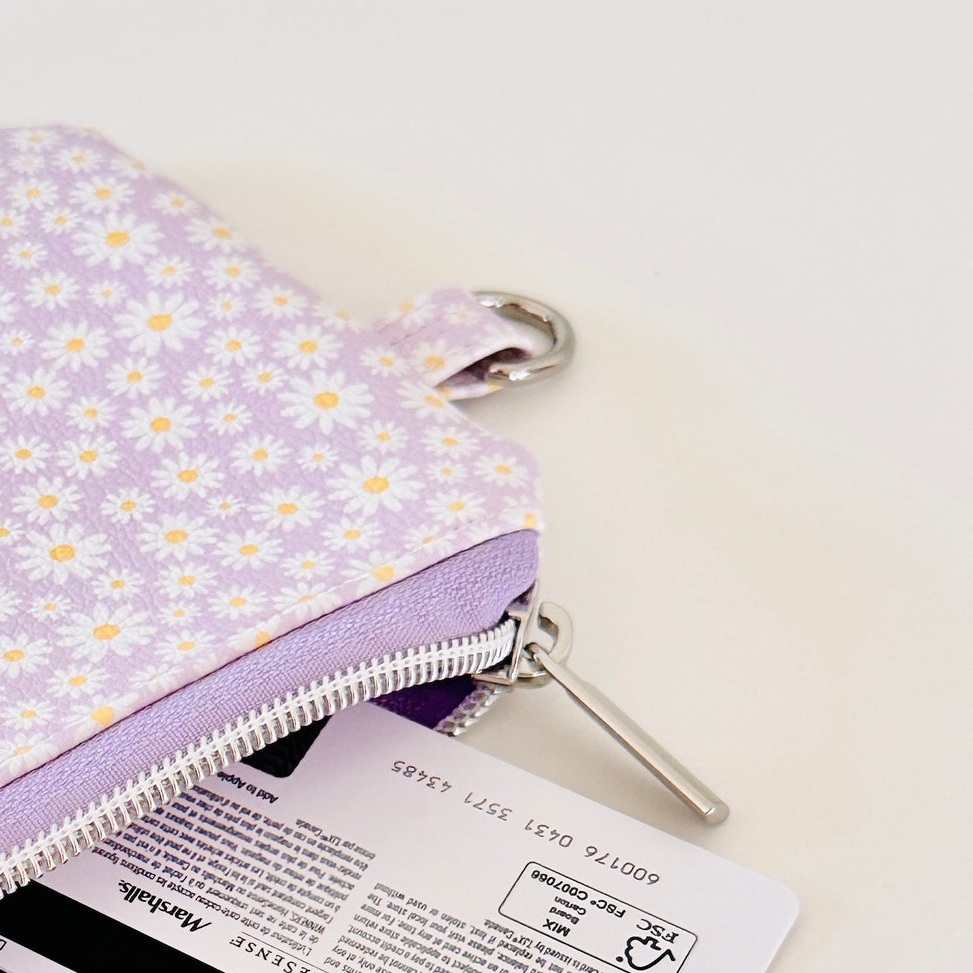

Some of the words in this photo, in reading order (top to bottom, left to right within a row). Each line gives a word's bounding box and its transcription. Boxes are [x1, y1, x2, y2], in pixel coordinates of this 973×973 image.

[216, 771, 247, 789] Apple
[391, 760, 451, 792] 43485
[245, 783, 257, 795] to
[255, 788, 277, 804] Add
[464, 792, 512, 821] 3571
[524, 819, 573, 848] 0431
[584, 845, 660, 885] 600176
[373, 882, 405, 900] without
[367, 893, 383, 906] The
[405, 897, 427, 911] used
[554, 896, 586, 915] Carton
[360, 903, 382, 917] more
[428, 908, 439, 916] or
[548, 906, 580, 925] Board
[353, 913, 379, 929] return
[380, 913, 396, 926] For
[406, 912, 429, 927] local
[440, 913, 467, 929] stolen
[378, 925, 400, 939] store
[428, 921, 448, 934] your
[542, 918, 571, 937] MIX
[636, 918, 679, 944] FSC
[417, 929, 433, 941] any
[432, 937, 443, 946] at
[447, 930, 466, 943] visit
[487, 935, 497, 944] if
[331, 944, 347, 957] any
[337, 935, 378, 957] redeemed
[379, 940, 405, 956] credit
[400, 936, 441, 959] applicable
[441, 941, 461, 955] card
[467, 939, 495, 955] please
[496, 939, 533, 960] replaced
[533, 941, 546, 953] by
[323, 956, 341, 968] and
[345, 952, 357, 961] at
[377, 953, 390, 965] be
[403, 951, 411, 959] a
[410, 953, 427, 965] pay
[441, 955, 451, 965] to
[461, 950, 487, 966] active
[535, 956, 547, 968] be
[543, 947, 572, 965] issued
[424, 961, 435, 971] to
[486, 962, 499, 972] an
[547, 962, 564, 973] not
[572, 959, 581, 969] is
